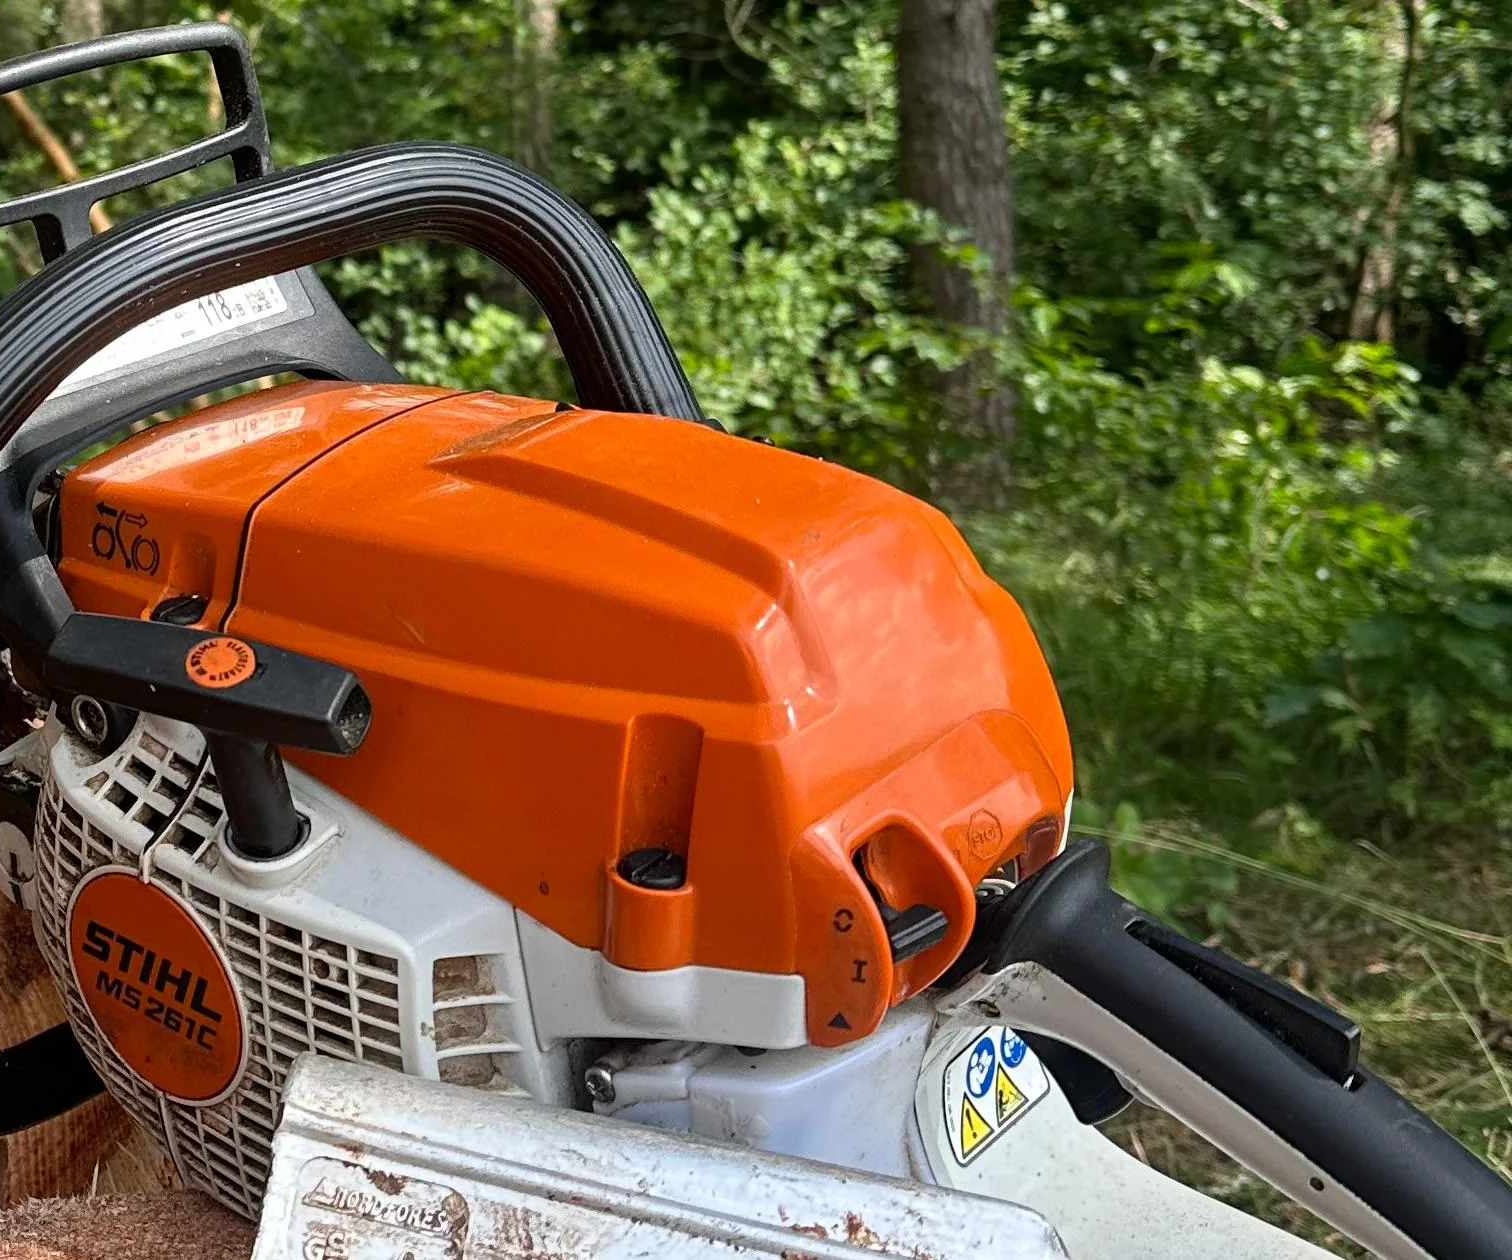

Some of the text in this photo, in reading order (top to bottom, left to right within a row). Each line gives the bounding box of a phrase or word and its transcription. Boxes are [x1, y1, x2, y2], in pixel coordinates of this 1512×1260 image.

[198, 292, 232, 326] 118
[82, 920, 223, 1023] STIHL
[95, 970, 143, 1010] MS
